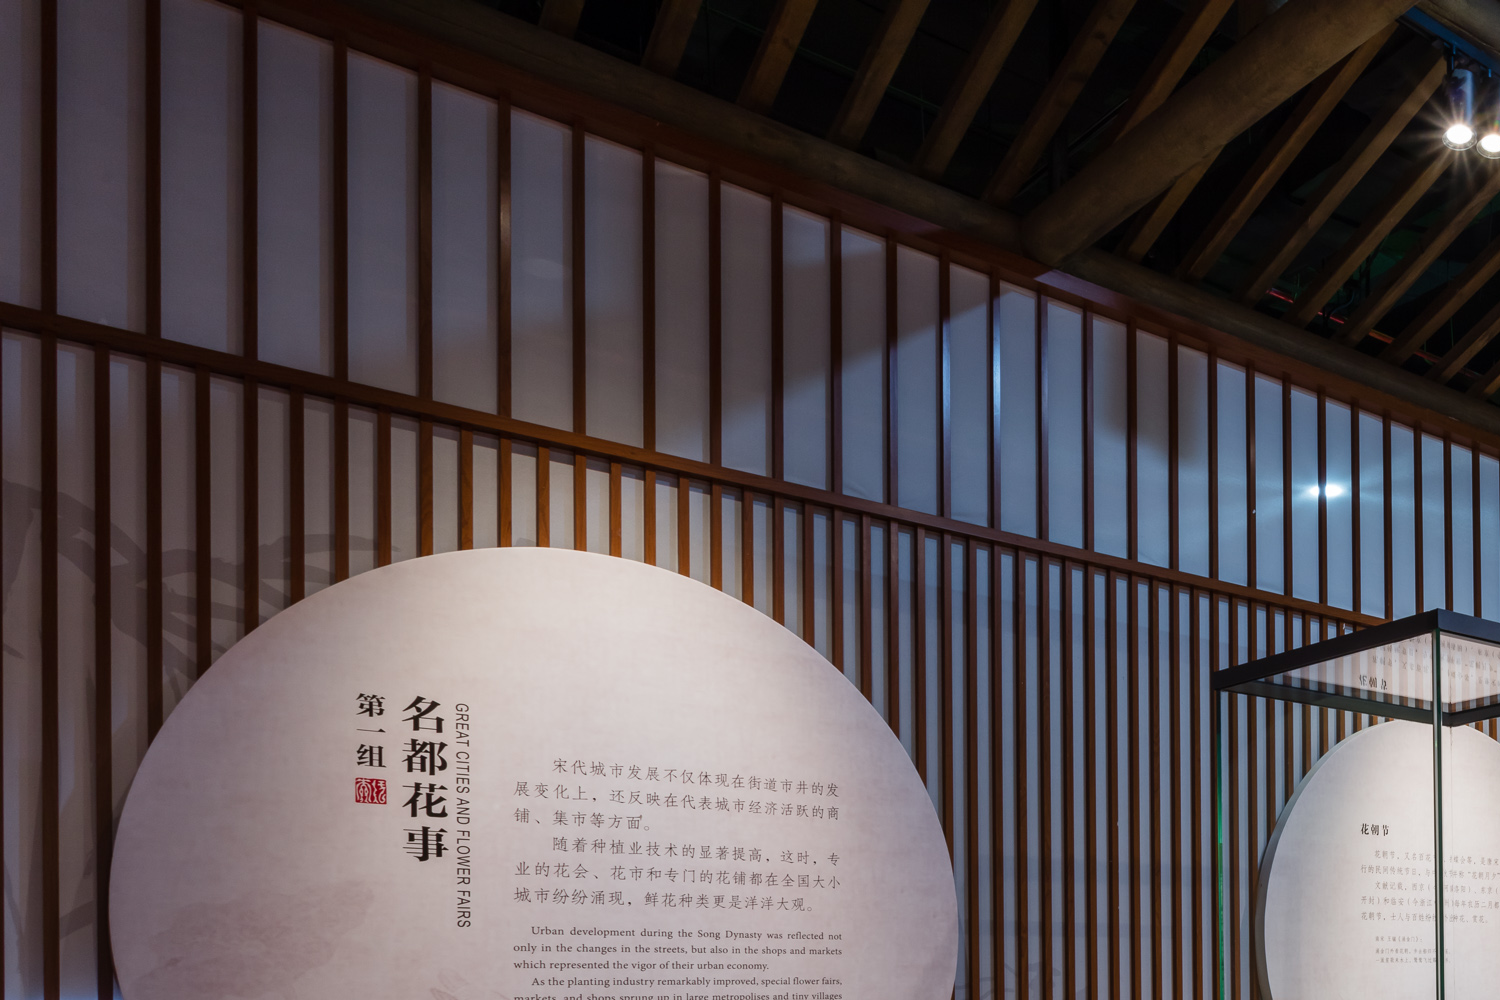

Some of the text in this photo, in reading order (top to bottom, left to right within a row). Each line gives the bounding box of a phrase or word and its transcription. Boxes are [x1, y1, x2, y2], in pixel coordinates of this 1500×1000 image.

[355, 692, 387, 768] 第一组
[401, 695, 449, 862] 名都花事
[552, 757, 840, 798] 宋代城市发展不仅体现在街道市井的发
[513, 780, 840, 821] 展变化上，还反映在代表城市经济活跃的商
[455, 703, 471, 928] GREAT CITIES AND FLOWER FAIRS
[513, 807, 650, 832] 铺、集市等方面。
[1361, 823, 1390, 836] 花朝节
[552, 836, 841, 867] 随着种植业技术的显著提高，这时，专
[513, 860, 841, 890] 业的花会、花市和专门的花铺都在全国大小
[513, 886, 813, 912] 城市纷纷涌现，鲜花种类更是洋洋大观。
[531, 926, 564, 936] Urban
[570, 927, 635, 938] development
[640, 929, 673, 939] during
[678, 929, 693, 938] the
[697, 930, 721, 940] Song
[726, 931, 762, 940] Dynasty
[787, 932, 824, 940] reflected
[513, 943, 537, 954] only
[541, 944, 551, 952] in
[556, 944, 572, 952] the
[576, 944, 617, 954] changes
[621, 945, 631, 953] in
[635, 945, 650, 953] the
[654, 946, 688, 954] streets,
[691, 946, 706, 954] but
[710, 946, 728, 954] also
[762, 947, 787, 956] shops
[790, 947, 806, 955] and
[809, 947, 842, 955] markets
[514, 960, 769, 971] which represented the vigor of their urban economy.
[531, 977, 842, 988] As the planting industry remarkably improved, special flower fairs,
